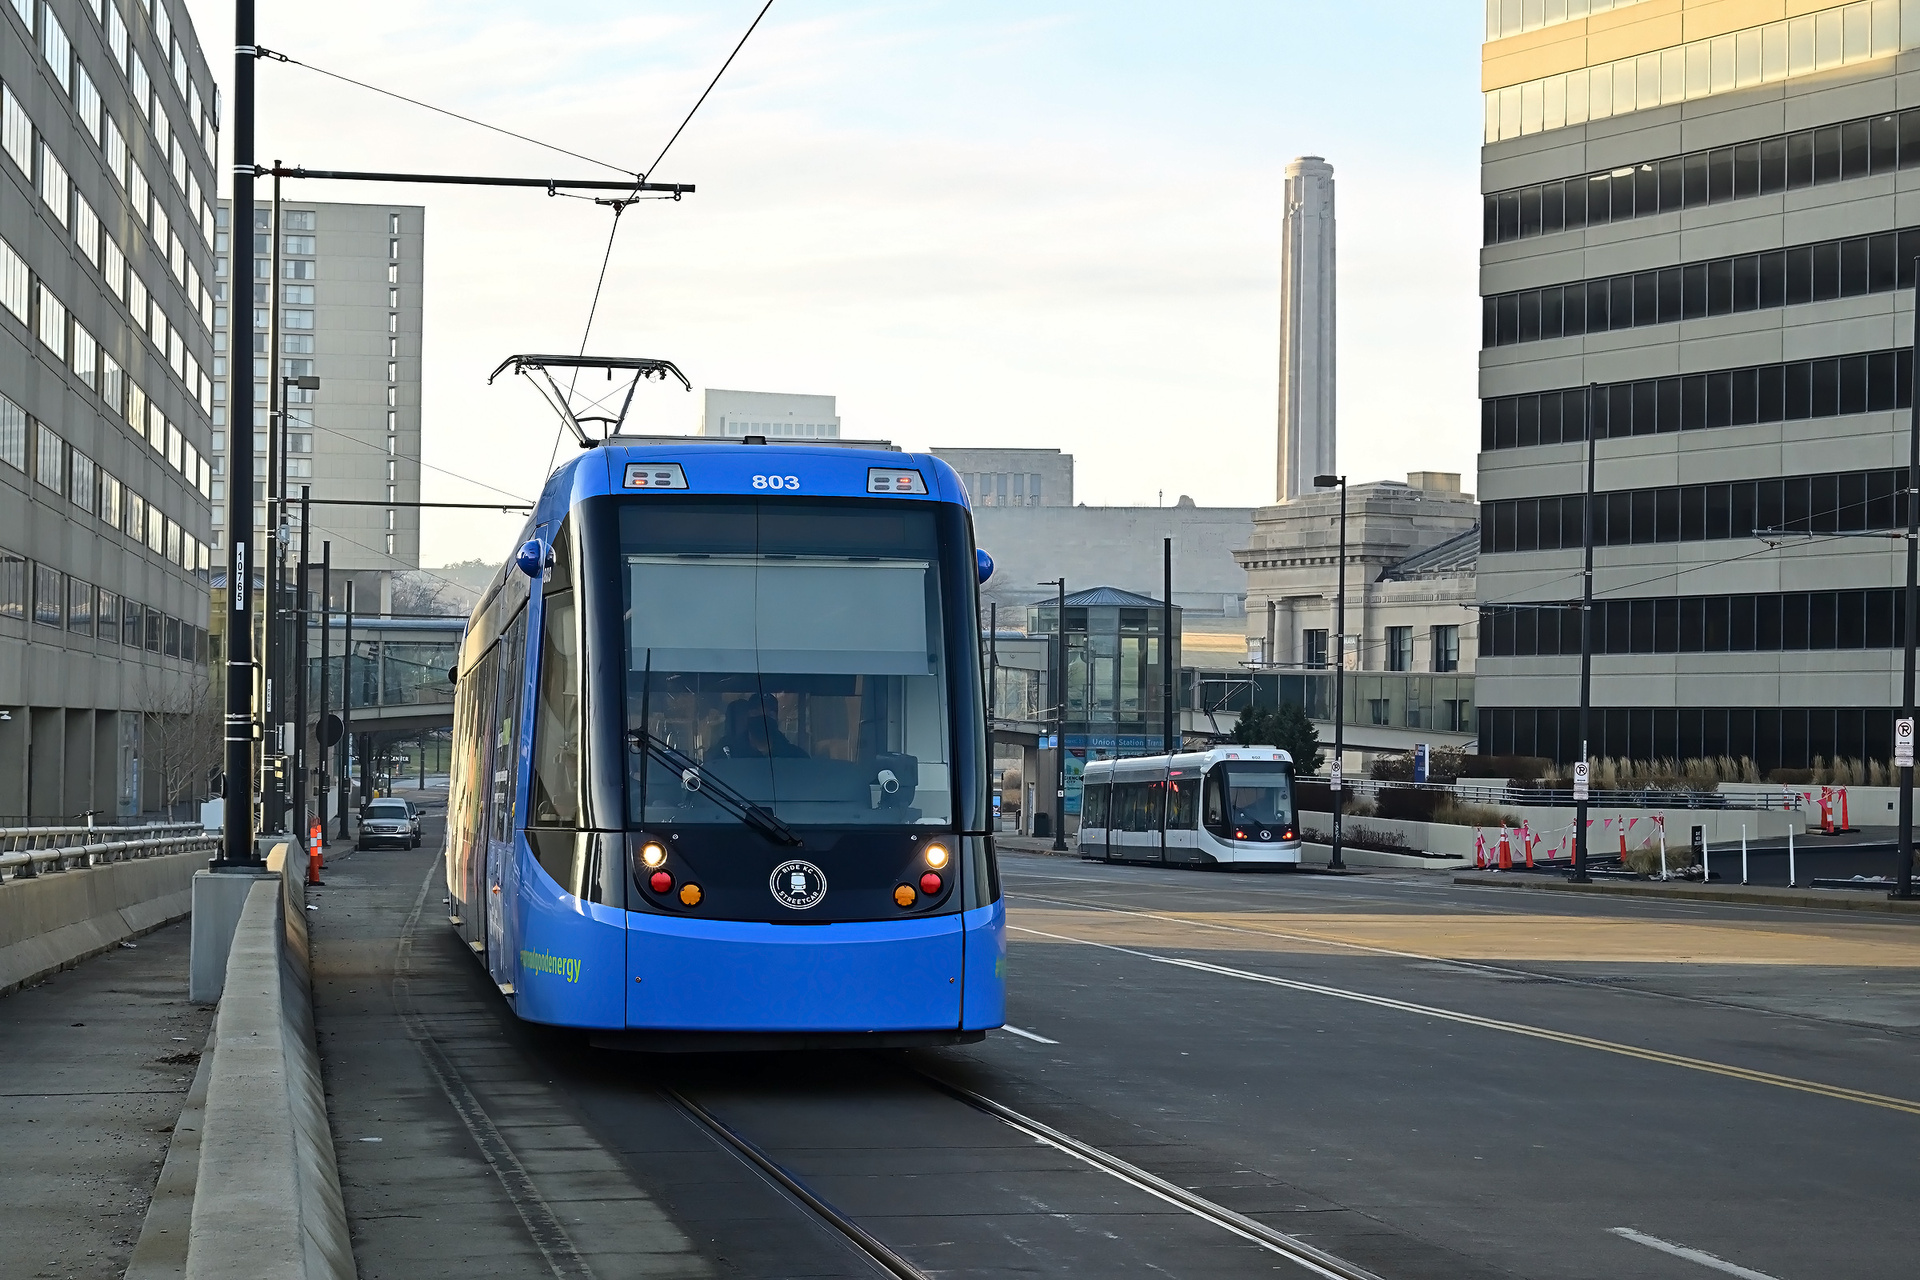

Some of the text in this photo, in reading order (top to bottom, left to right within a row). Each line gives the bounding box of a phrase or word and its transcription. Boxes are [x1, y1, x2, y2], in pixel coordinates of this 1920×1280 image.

[752, 475, 800, 490] 803
[1092, 738, 1115, 746] Union
[1118, 738, 1144, 746] Station
[781, 864, 814, 875] RIDE KC
[778, 890, 819, 905] STREETCAR
